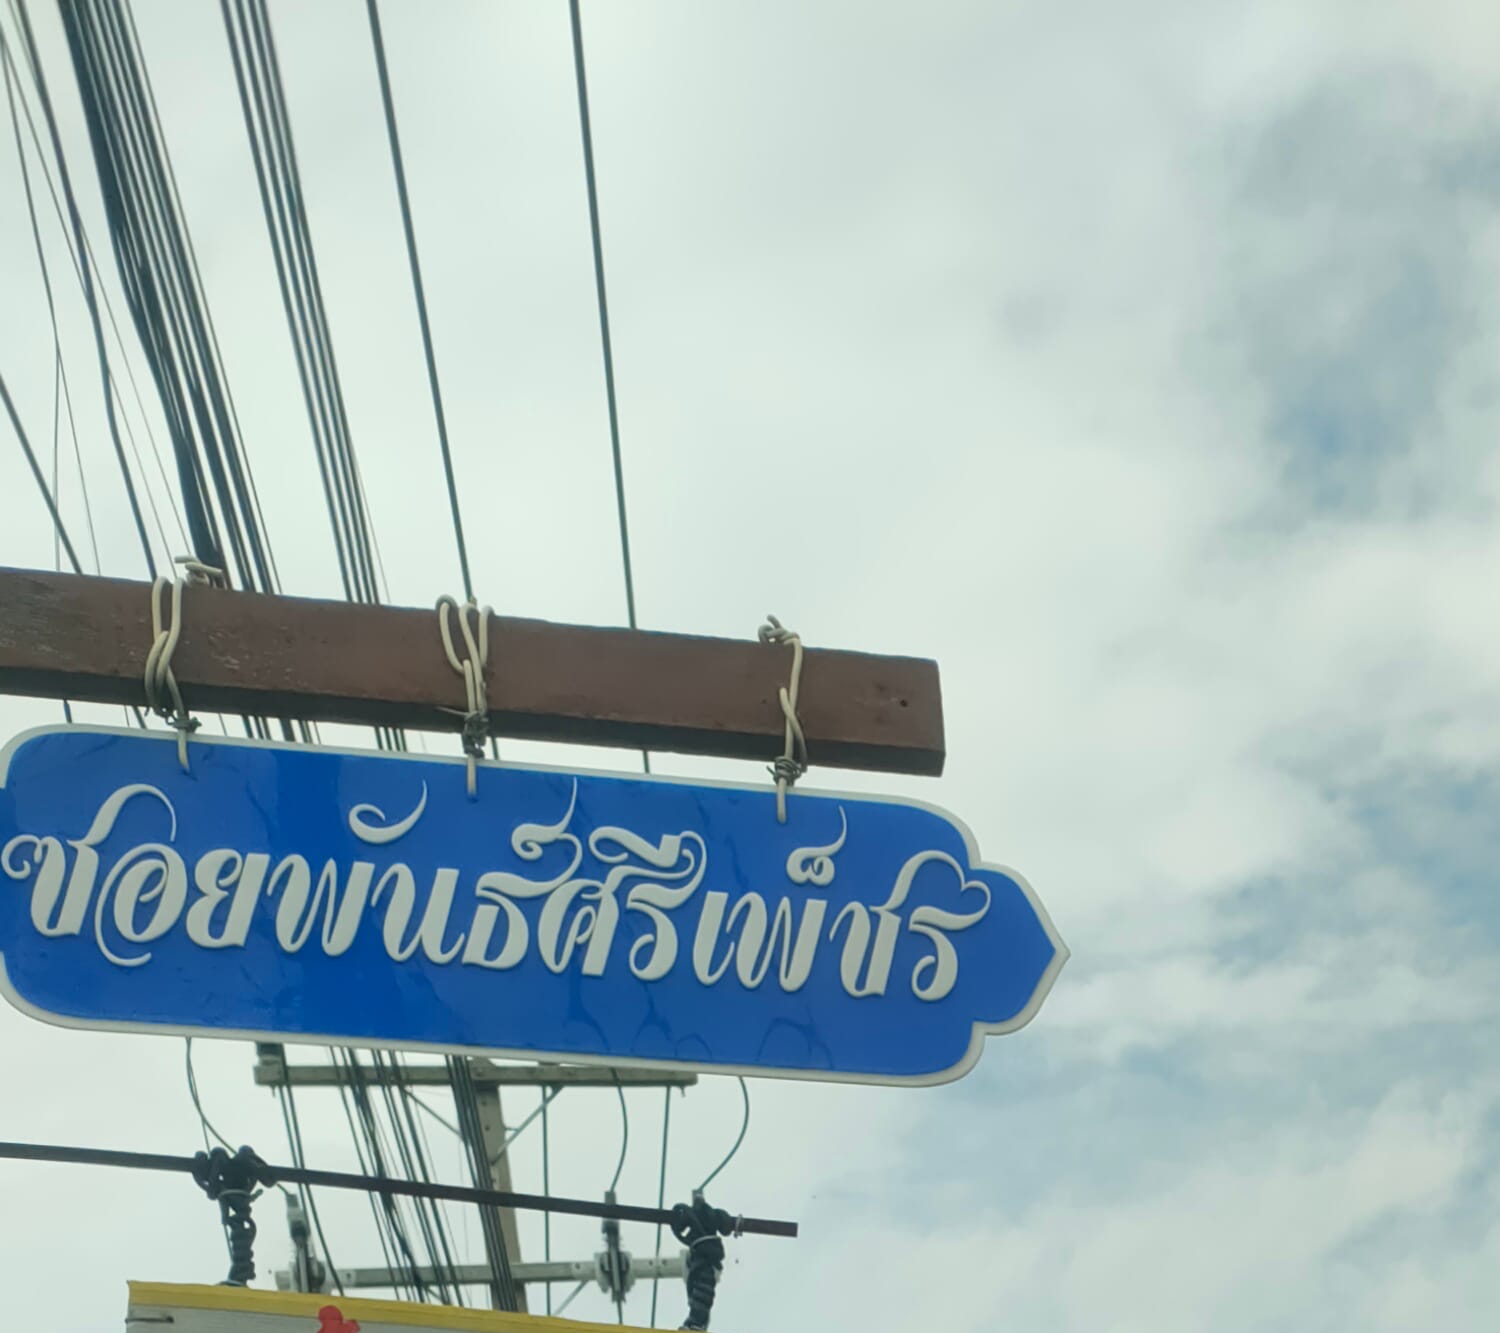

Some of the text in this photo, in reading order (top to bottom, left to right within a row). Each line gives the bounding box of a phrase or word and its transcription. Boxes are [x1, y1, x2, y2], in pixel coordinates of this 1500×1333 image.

[1, 776, 991, 1000] ซอยพันธ์ศรีเพ็ชร
